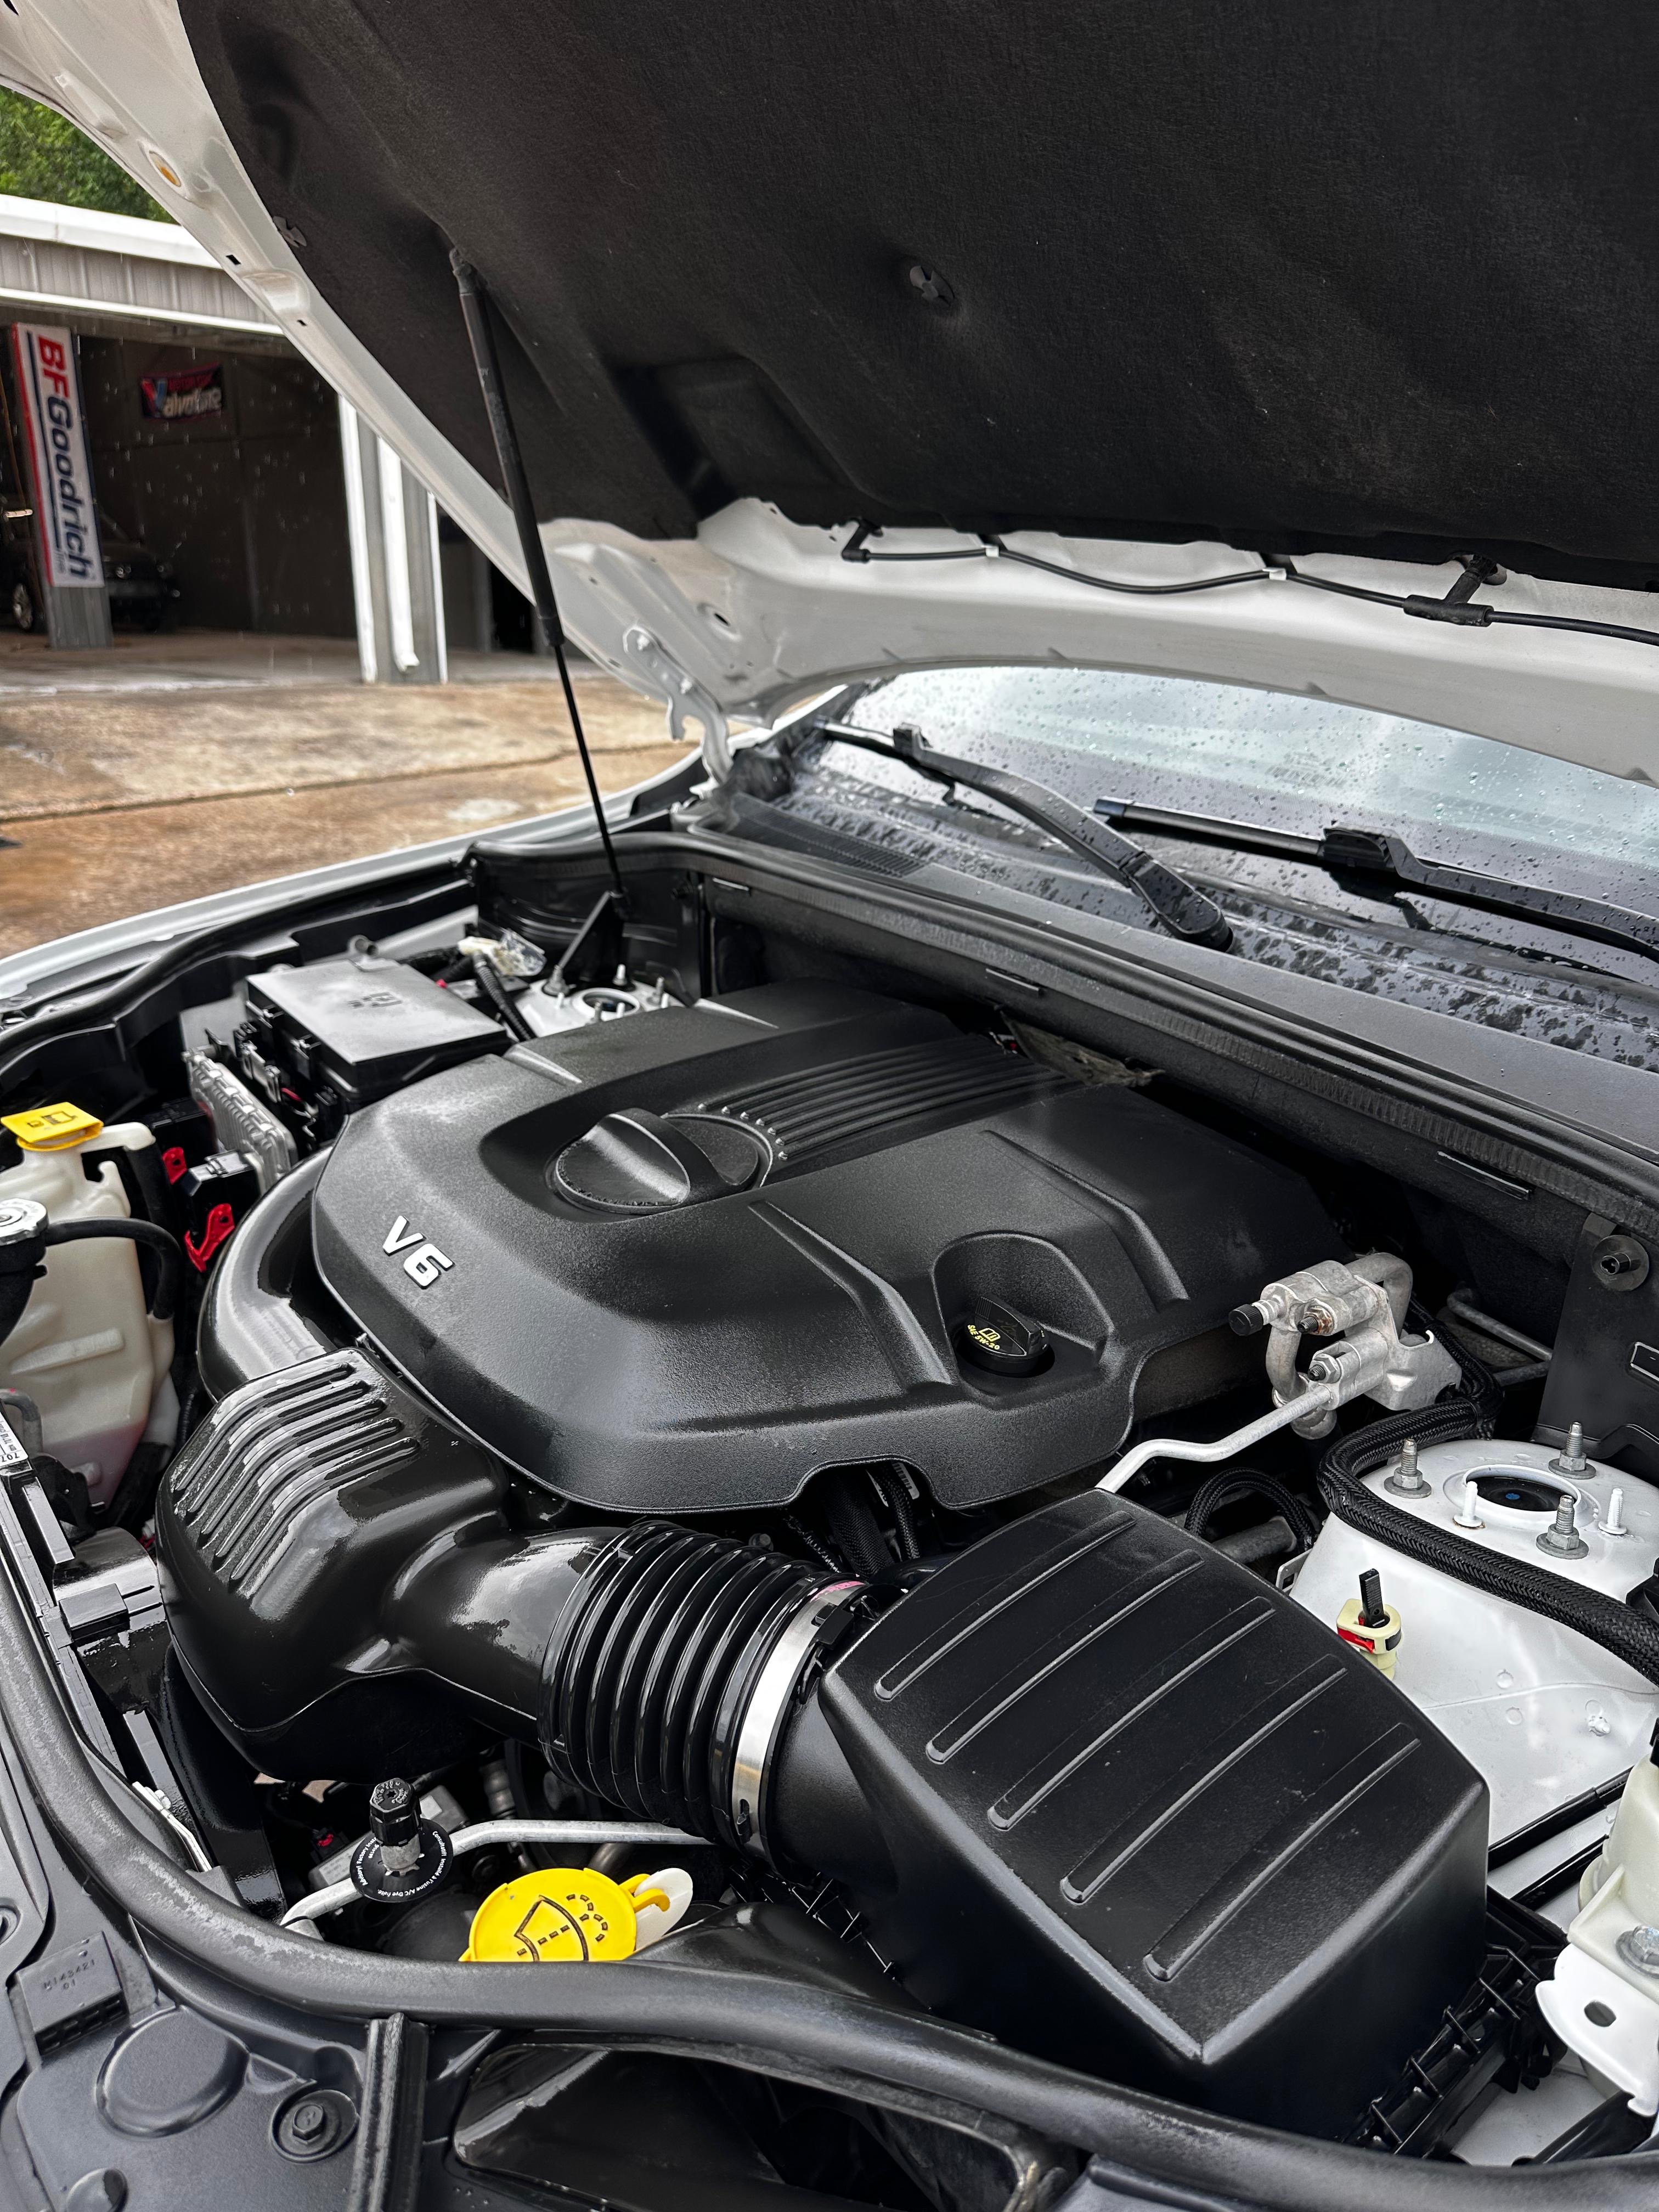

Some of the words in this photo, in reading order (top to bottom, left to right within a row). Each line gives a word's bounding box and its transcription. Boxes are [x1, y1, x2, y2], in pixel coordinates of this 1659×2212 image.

[38, 337, 92, 578] BFGoodrich
[383, 1215, 454, 1290] V6
[967, 1324, 979, 1336] SAE
[974, 1335, 1000, 1350] 5W-20
[405, 1888, 415, 1897] A/C
